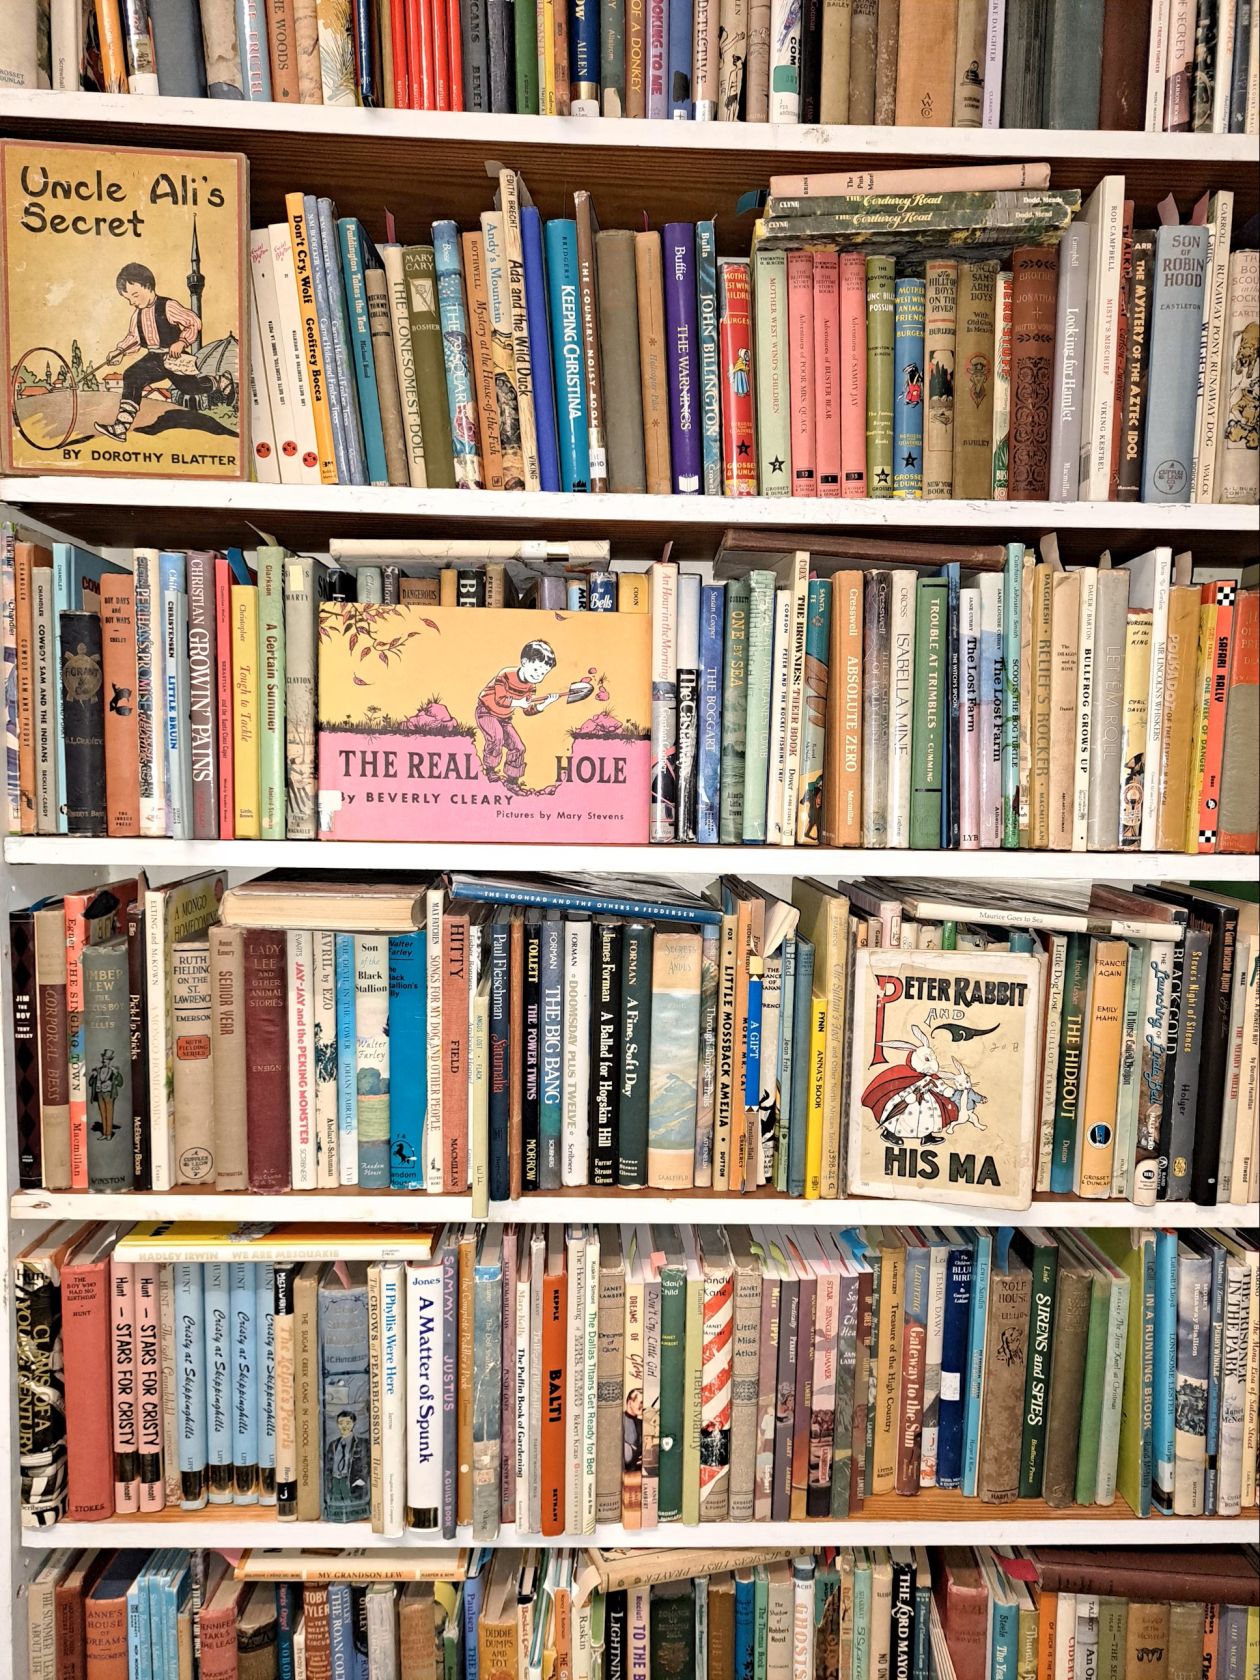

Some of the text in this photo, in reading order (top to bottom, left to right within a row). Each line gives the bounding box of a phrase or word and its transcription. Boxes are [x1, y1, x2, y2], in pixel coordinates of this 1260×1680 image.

[278, 22, 289, 70] WOODS
[632, 0, 641, 93] OF A DONKEY
[1175, 12, 1187, 60] SECRETS
[577, 40, 587, 77] ALLEN
[652, 52, 663, 70] TO
[20, 165, 225, 208] Uncle Ali's
[20, 201, 145, 238] Secret
[292, 215, 306, 246] Don't
[405, 254, 434, 262] MARY
[1172, 234, 1201, 248] SON
[405, 262, 434, 271] CARY
[674, 246, 684, 281] Buffie
[1163, 258, 1204, 272] ROBIN
[1164, 273, 1202, 288] HOOD
[301, 274, 313, 304] Wolf
[505, 174, 533, 396] EDITH BRECHT Ada and the Wild Duck
[305, 317, 320, 366] Geoffrey
[561, 285, 582, 420] KEEPING CHRISTINA
[700, 233, 717, 436] Bulla JOHN BILLINGTON
[1127, 260, 1146, 460] THE MYSTERY OF THE AZTEC IDOL
[312, 369, 322, 402] Bocca
[63, 449, 236, 466] BY DOROTHY BLATTER
[590, 592, 613, 610] Bells
[38, 624, 47, 669] COWBOY
[927, 597, 940, 729] TROUBLE AT TRIMBLES
[188, 559, 212, 782] CHRISTIAN GROWIN' PAINS
[266, 623, 278, 733] A Certain Summer
[966, 636, 977, 732] The Lost Farm
[1214, 636, 1228, 703] SAFARI RALLY
[168, 676, 177, 709] LITTLE
[704, 666, 717, 752] THE BOGGART
[845, 656, 860, 773] ABSOLUTE ZERO
[1080, 648, 1092, 774] BULLFROG GROWS UP
[40, 733, 48, 763] INDIANS
[168, 715, 177, 750] BRUIN
[339, 750, 627, 784] THE REAL HOLE
[366, 792, 514, 806] BEVERLY CLEARY
[496, 810, 624, 821] Pictures by Mary Stevens
[450, 923, 464, 980] HITTY
[602, 964, 616, 1002] Forman
[1098, 969, 1122, 977] AGAIN
[218, 970, 234, 1036] SENIOR YEAR
[627, 996, 639, 1008] A
[954, 976, 1028, 1007] RABBIT
[526, 938, 539, 1101] FOLLETT THE POWER TWINS
[543, 931, 561, 1105] FORMAN THE BIG BANG
[600, 1011, 614, 1022] A
[818, 1011, 826, 1033] FYNN
[925, 1008, 965, 1027] AND
[1096, 1014, 1119, 1022] HAHN
[450, 1040, 460, 1074] FIELD
[600, 1024, 614, 1058] Ballad
[626, 1043, 639, 1070] Soft
[718, 965, 734, 1127] LITTLE MOSSBACK AMELIA
[749, 1020, 759, 1059] A GIFT
[599, 1060, 613, 1078] for
[1060, 1014, 1081, 1121] THE HIDEOUT
[596, 1081, 613, 1124] Hogskin
[622, 1074, 638, 1098] Day
[814, 1084, 822, 1110] BOOK
[597, 1127, 612, 1147] Hill
[884, 1146, 1001, 1186] HIS MA
[412, 1276, 440, 1286] Jones
[383, 1283, 396, 1395] If Phyllis Were Here
[890, 1302, 899, 1341] Treasure
[115, 1276, 135, 1446] Hunt STARS FOR CRISTY
[890, 1344, 896, 1353] of
[1028, 1293, 1052, 1426] SIRENS and SPIES
[417, 1296, 435, 1464] A Matter of Spunk
[548, 1369, 563, 1423] BALTI
[886, 1372, 895, 1394] High
[903, 1326, 924, 1448] Gateway to the Sun
[884, 1396, 894, 1433] Country
[304, 1590, 328, 1604] TOBY
[899, 1572, 910, 1600] THE
[466, 1592, 478, 1633] Paulsen
[485, 1629, 513, 1638] DIDDIE
[492, 1650, 508, 1658] AND
